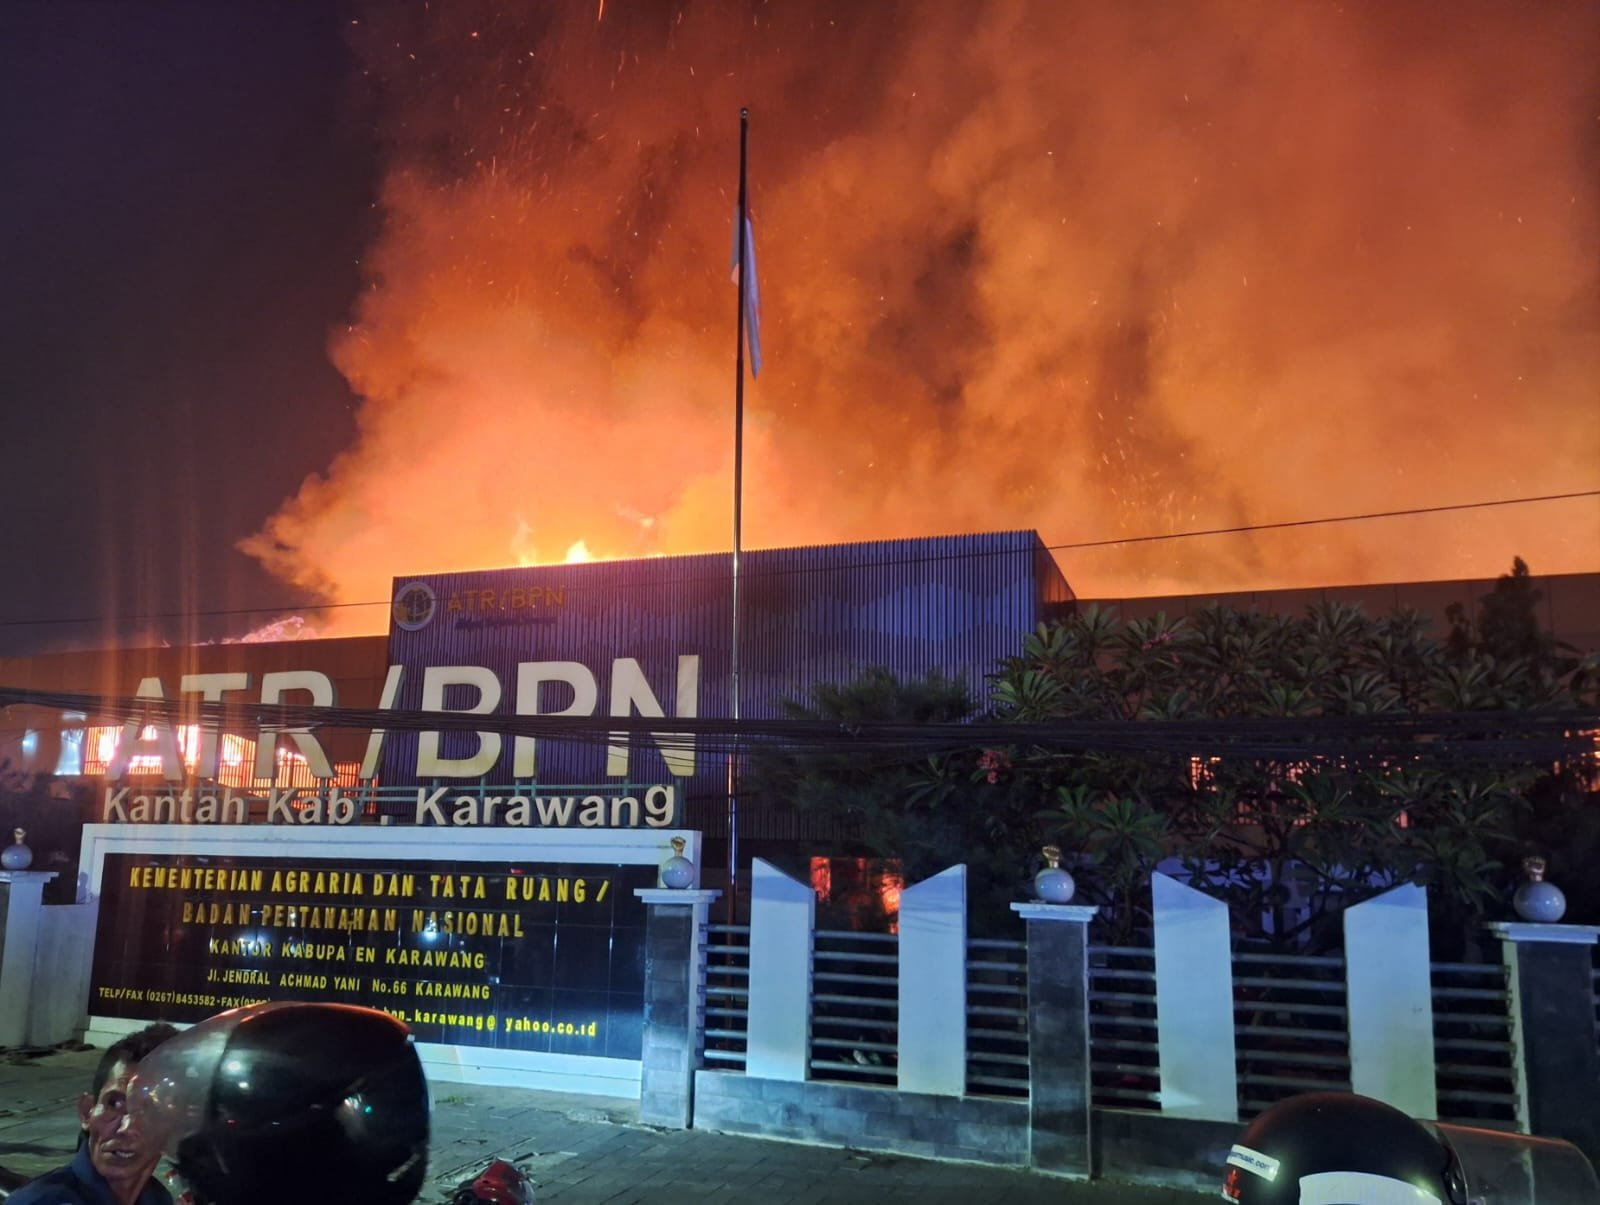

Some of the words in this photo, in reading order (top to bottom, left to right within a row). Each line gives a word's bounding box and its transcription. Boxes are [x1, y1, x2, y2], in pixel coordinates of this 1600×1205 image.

[105, 655, 699, 780] ATR/BPN
[103, 787, 245, 825] Kantah
[266, 787, 355, 825] Kab
[415, 784, 675, 828] Karawang
[129, 867, 262, 893] KEMENTERIAN
[271, 870, 363, 895] AGRARIA
[373, 873, 415, 897] DAN
[430, 875, 487, 899] TATA
[183, 902, 251, 925] BADAN
[261, 904, 397, 932] PERTANAHAN
[411, 908, 525, 937] NASIONAL
[209, 939, 272, 958] KANTOR
[385, 948, 485, 969] KARAWANG
[98, 986, 143, 1001] TELP/FAX
[279, 973, 328, 989] ACHMAD
[333, 976, 360, 992] YANI
[415, 981, 491, 1000] KARAWANG
